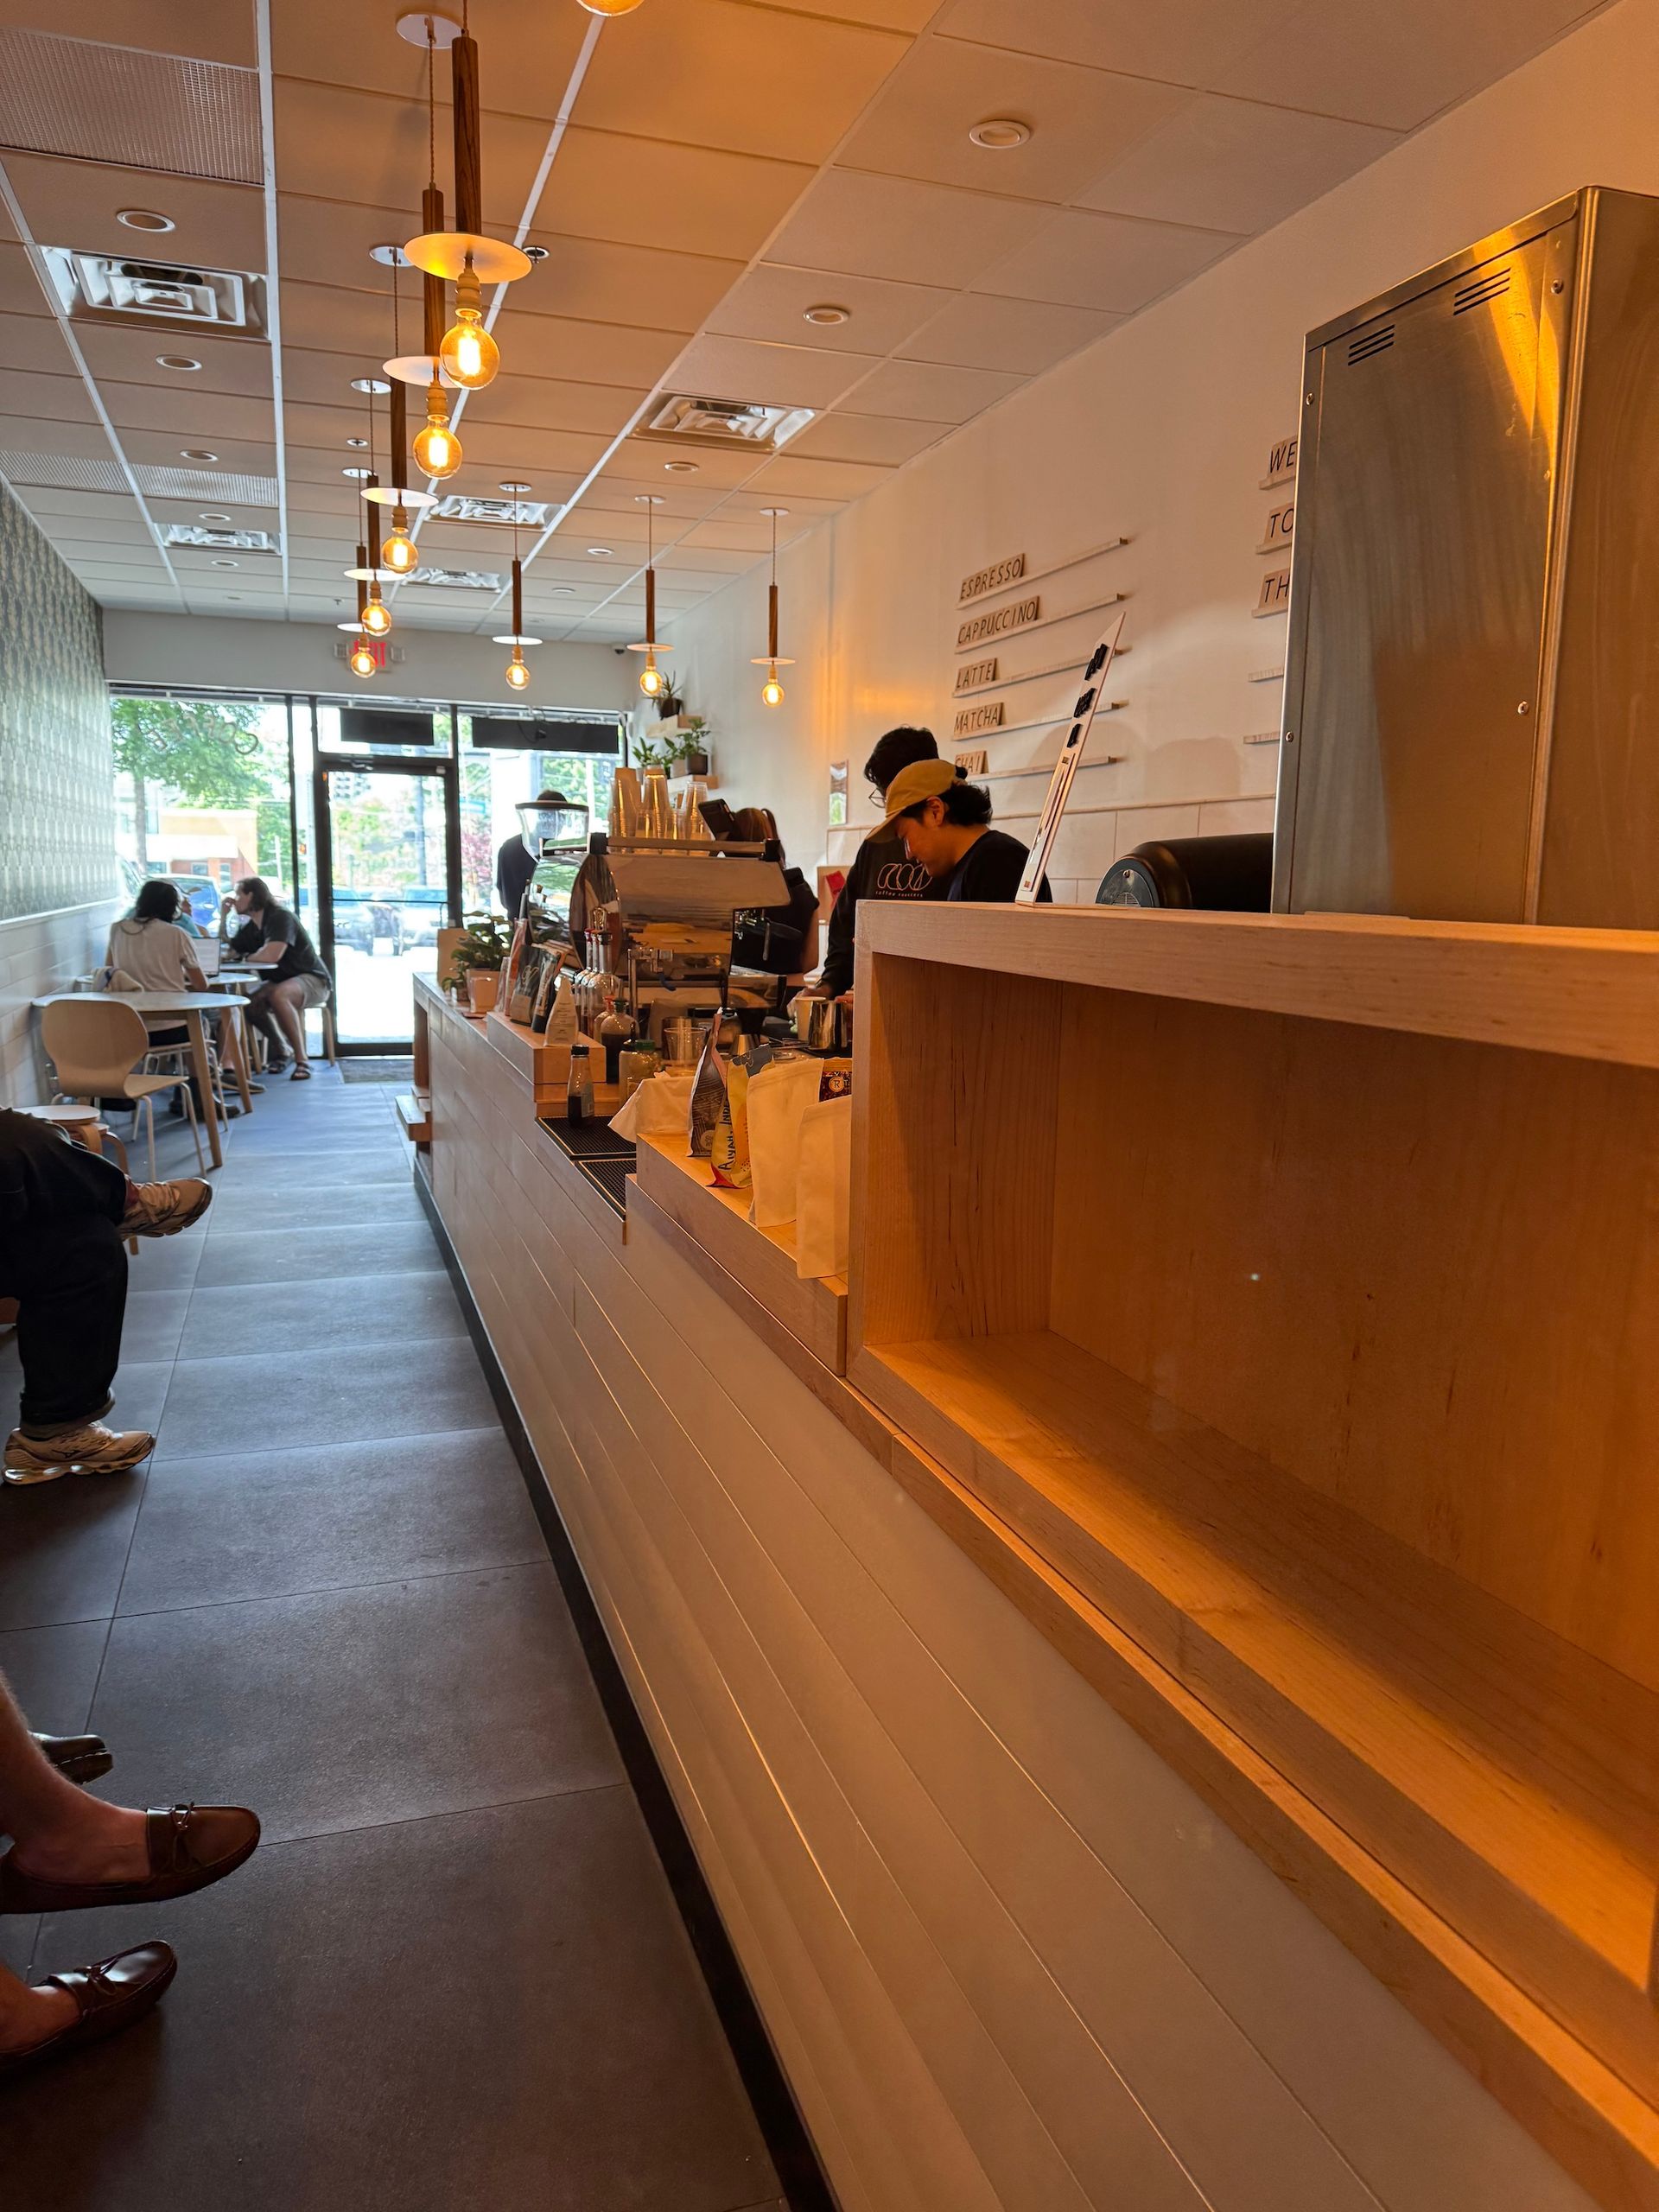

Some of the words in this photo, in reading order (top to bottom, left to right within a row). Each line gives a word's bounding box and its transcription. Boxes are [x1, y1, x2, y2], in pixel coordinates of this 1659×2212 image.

[1269, 441, 1298, 474] WE
[1270, 508, 1294, 538] TO
[960, 557, 1021, 601] ESPRESSO
[1264, 574, 1291, 603] TH
[957, 601, 1036, 645] CAPPUCCINO
[956, 663, 993, 689] LATTE
[954, 706, 999, 734] MATCHA
